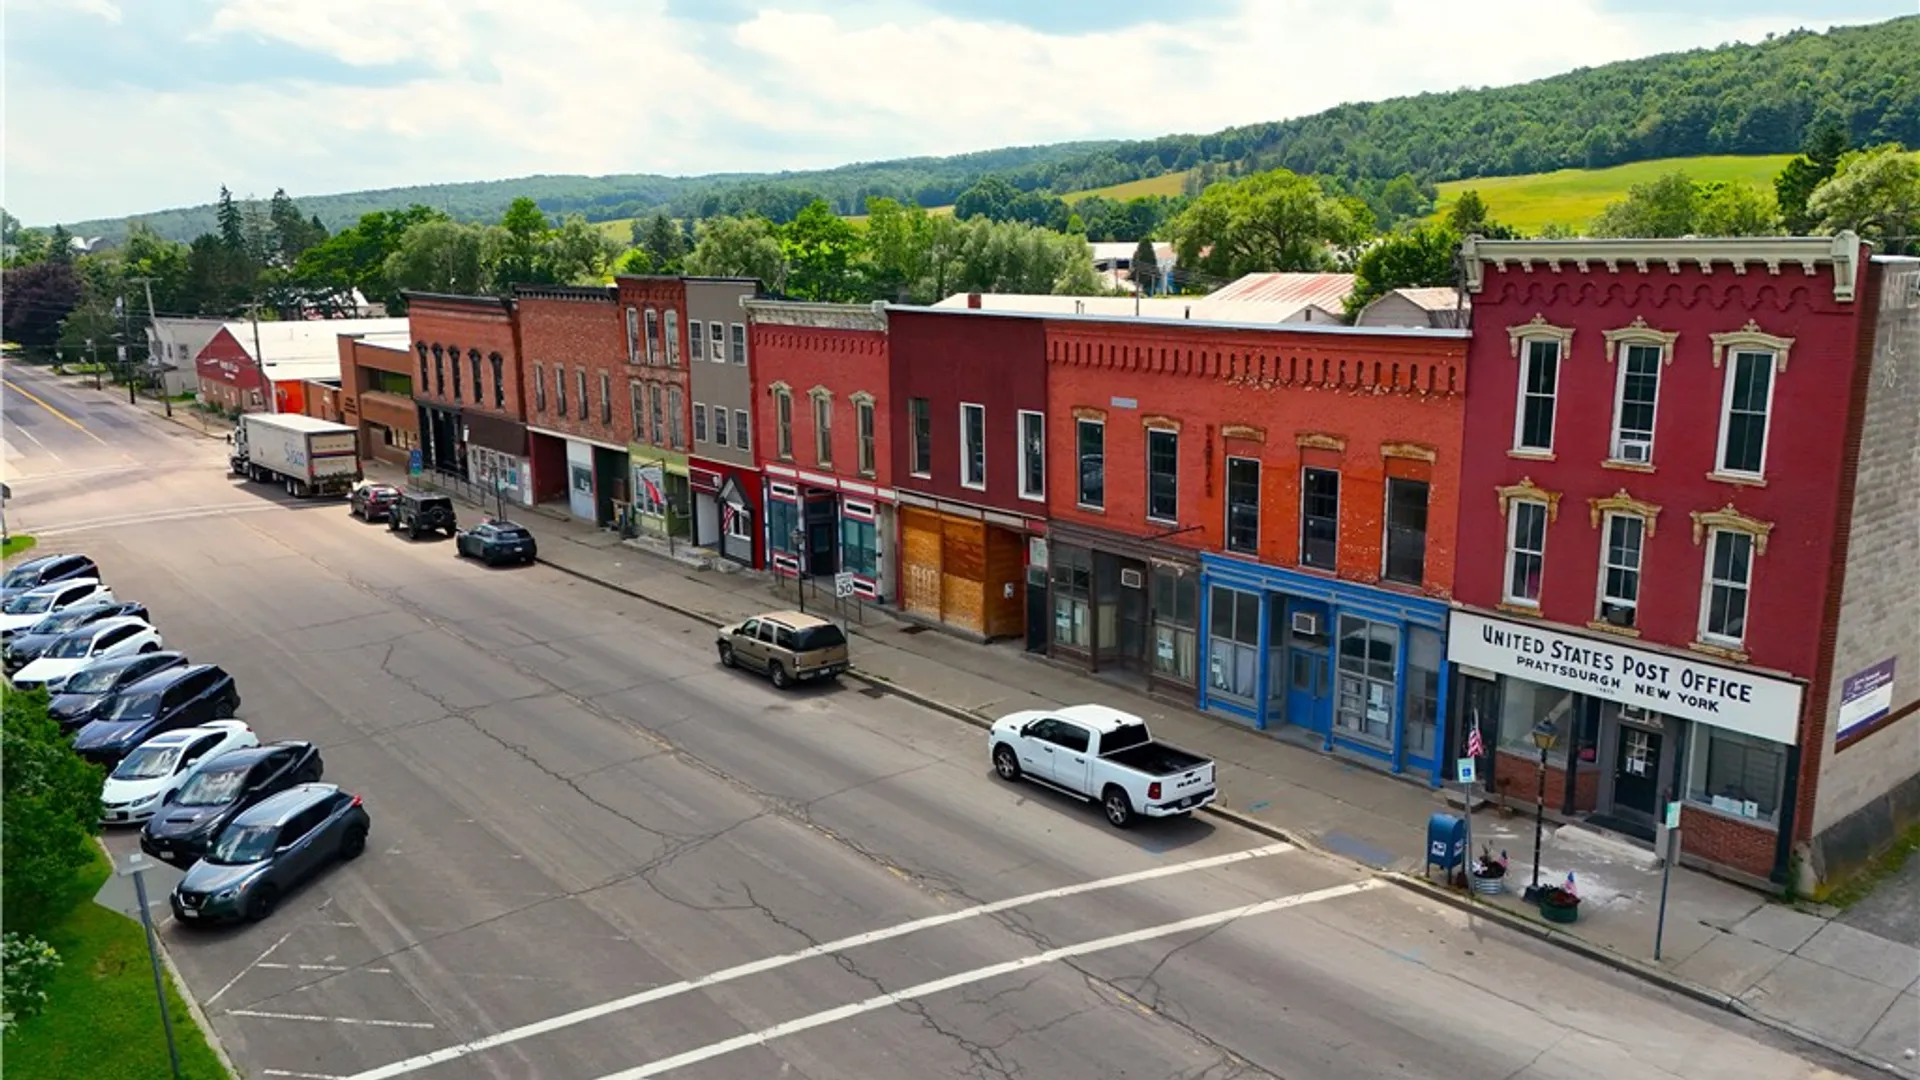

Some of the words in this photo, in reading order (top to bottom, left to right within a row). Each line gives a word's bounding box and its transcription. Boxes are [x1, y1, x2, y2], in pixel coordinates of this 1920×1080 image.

[1482, 624, 1545, 654] UNITED
[1550, 639, 1614, 671] STATES
[1623, 654, 1670, 684] POST
[1681, 668, 1753, 703] OFFICE
[1516, 655, 1621, 689] PRATTSBURGH
[1634, 683, 1671, 700] NEW
[1677, 691, 1720, 713] YORK
